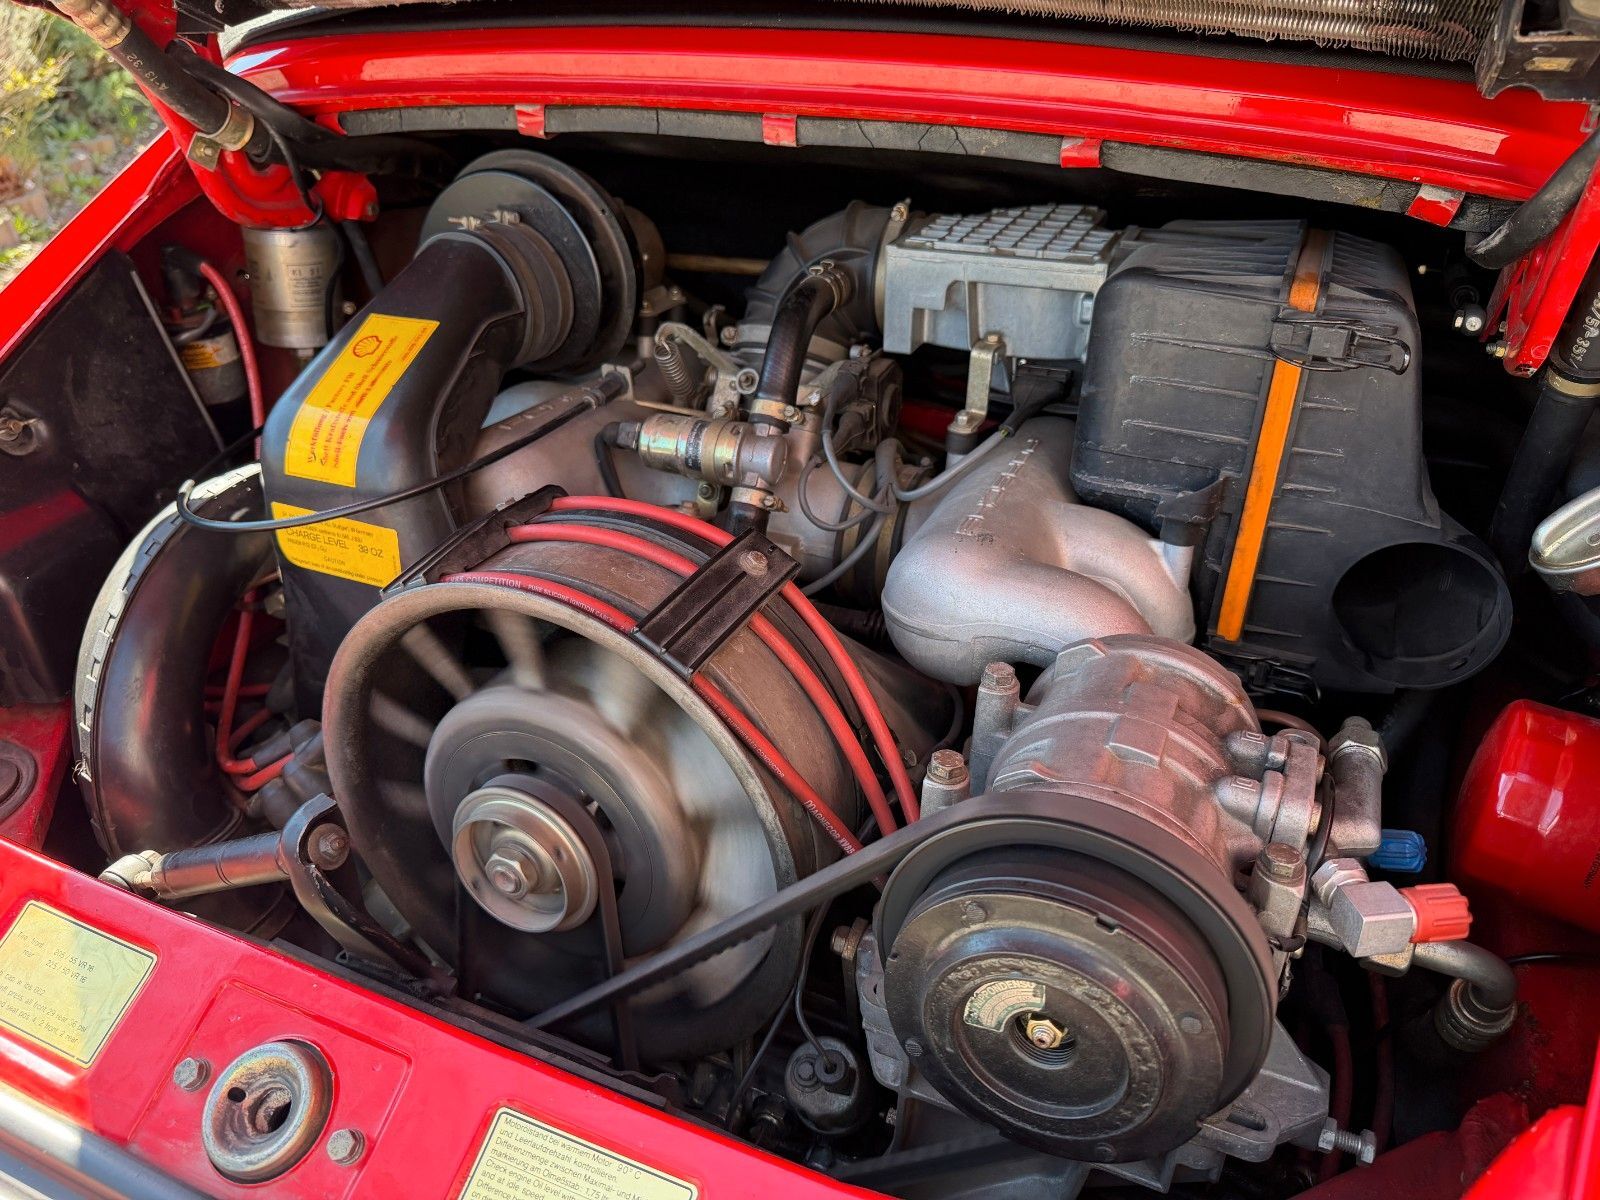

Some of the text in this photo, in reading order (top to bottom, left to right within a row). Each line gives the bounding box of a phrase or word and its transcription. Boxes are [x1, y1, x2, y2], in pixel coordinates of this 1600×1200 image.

[286, 526, 321, 543] CHARGE
[322, 535, 349, 549] LEVEL
[370, 547, 383, 558] OZ
[464, 575, 522, 588] COMPETITION
[805, 799, 841, 841] MAGNECOR
[498, 1127, 513, 1138] und
[489, 1147, 529, 1170] markierung
[529, 1164, 541, 1173] am
[493, 1136, 550, 1167] Differenzmenge
[549, 1160, 582, 1179] zwischen
[616, 1188, 631, 1200] und
[591, 1153, 612, 1167] Motor
[480, 1168, 495, 1180] and
[506, 1179, 520, 1191] idle
[485, 1157, 508, 1173] Check
[507, 1169, 532, 1186] engine
[532, 1178, 543, 1189] Oil
[543, 1184, 561, 1197] level
